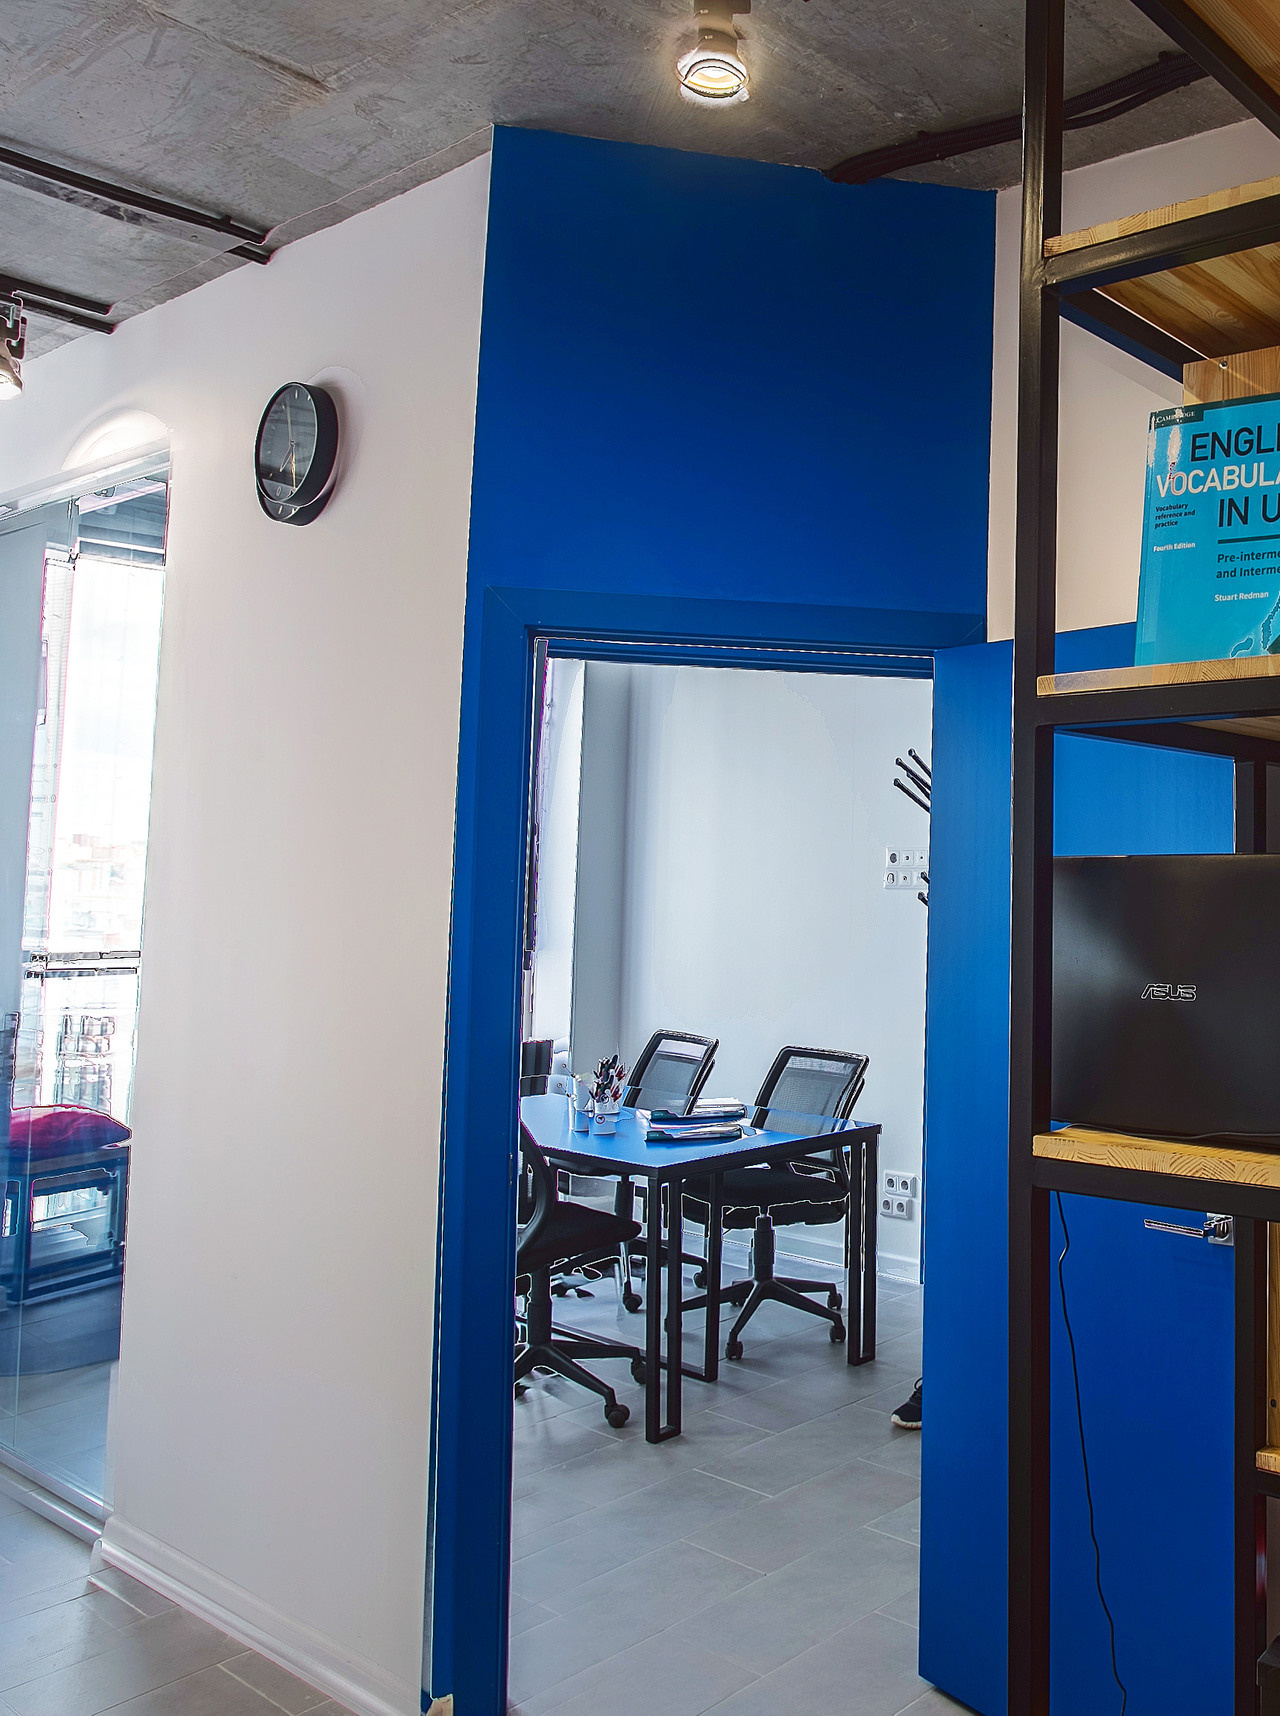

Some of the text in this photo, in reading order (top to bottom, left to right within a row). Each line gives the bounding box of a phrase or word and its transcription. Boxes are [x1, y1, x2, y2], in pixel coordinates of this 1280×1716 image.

[1156, 411, 1196, 423] CAMBDGE
[1155, 503, 1189, 512] Vocabulary
[1218, 496, 1250, 528] IN
[1155, 509, 1196, 520] reference and
[1154, 520, 1179, 530] practice
[1153, 542, 1196, 552] Fourth Edition
[1216, 567, 1237, 579] and
[1214, 591, 1269, 602] Stuart Redman
[1141, 983, 1197, 1002] ASUS
